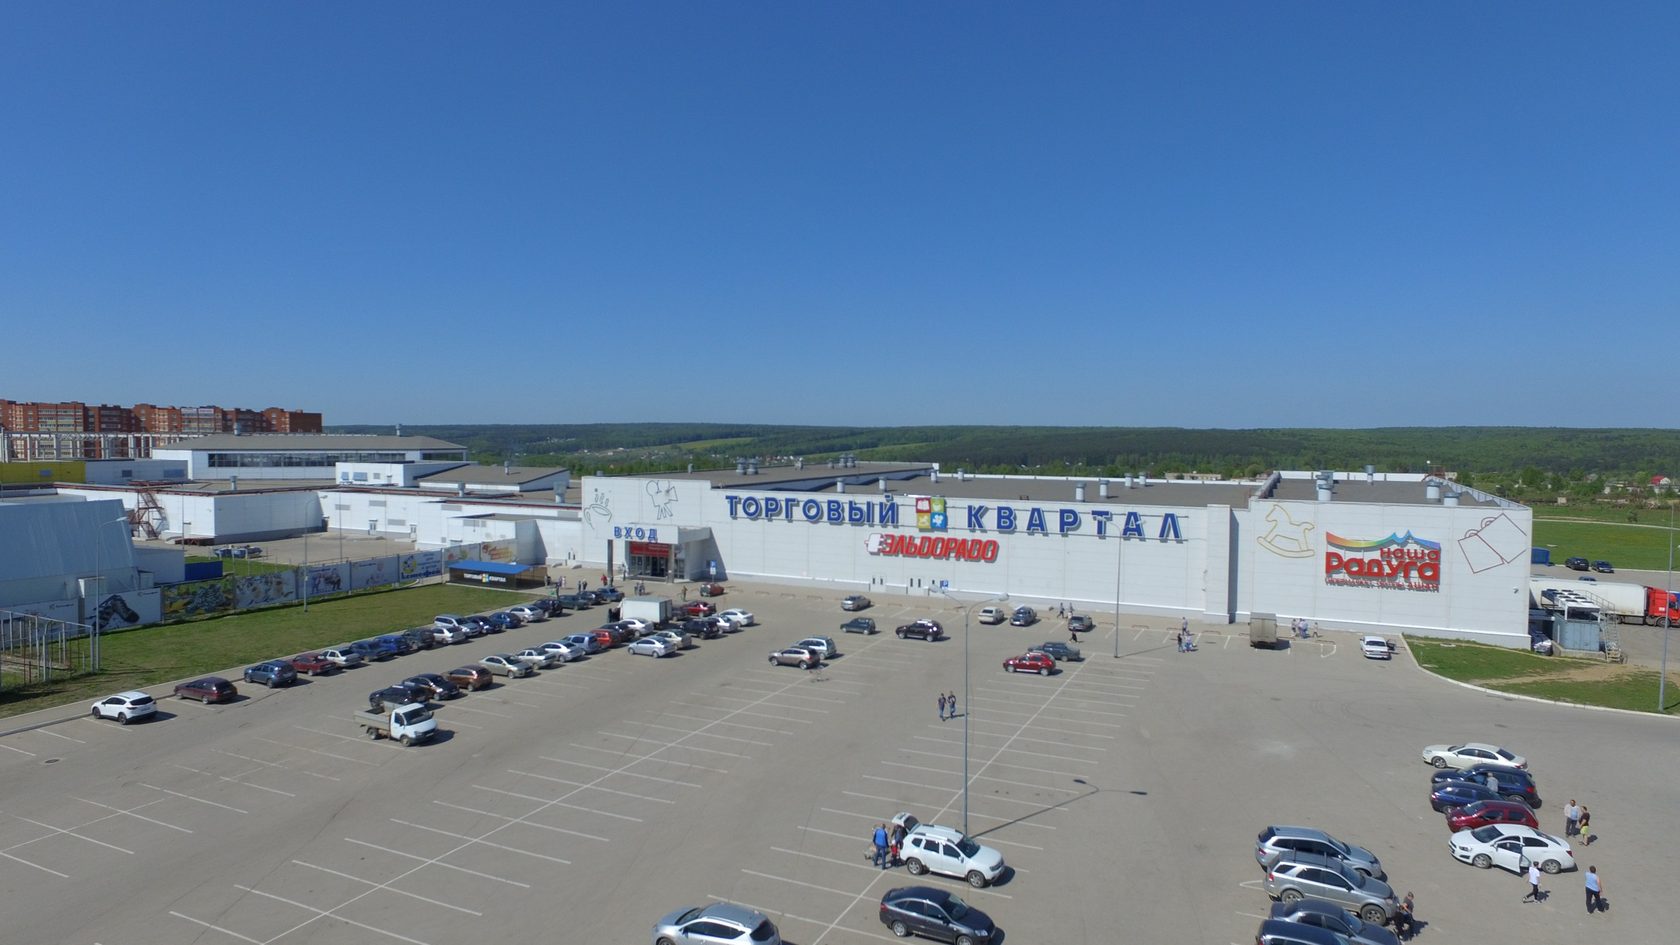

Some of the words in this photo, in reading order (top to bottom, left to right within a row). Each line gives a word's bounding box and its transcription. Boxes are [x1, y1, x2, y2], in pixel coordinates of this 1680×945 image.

[726, 494, 898, 525] ТОРГОВЫЙ
[967, 505, 1183, 539] КВАРТАЛ
[613, 526, 658, 541] ВХОД
[1325, 552, 1440, 581] Радуга
